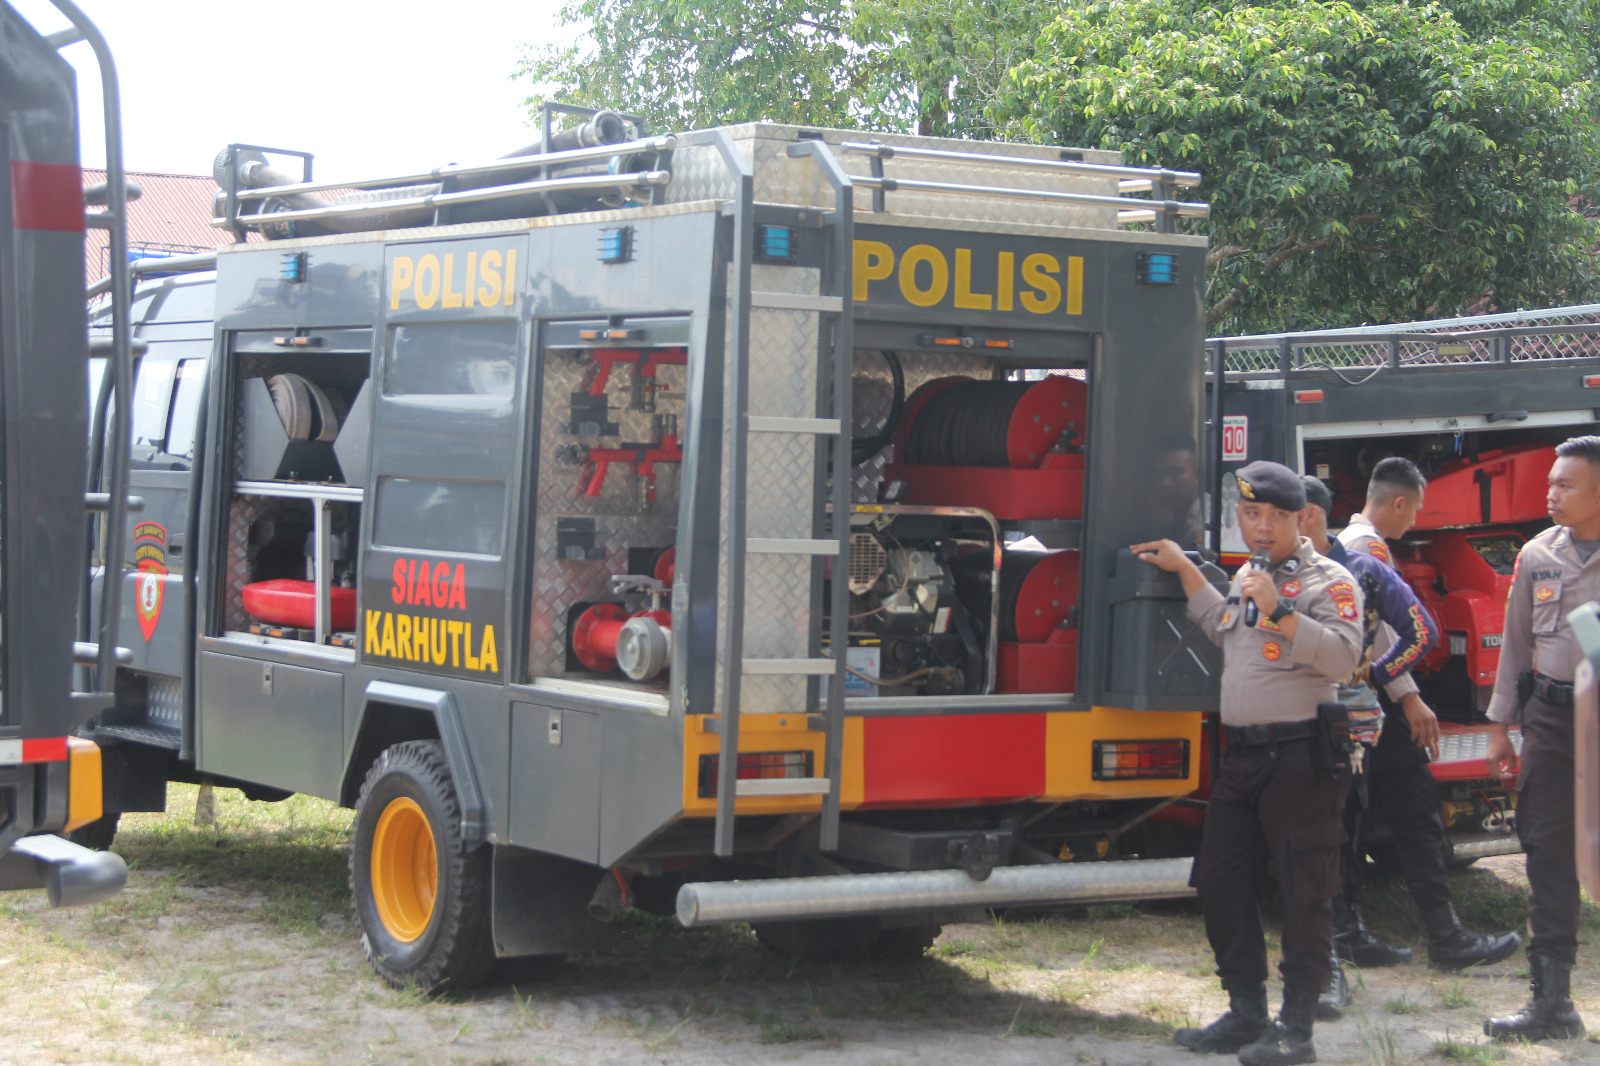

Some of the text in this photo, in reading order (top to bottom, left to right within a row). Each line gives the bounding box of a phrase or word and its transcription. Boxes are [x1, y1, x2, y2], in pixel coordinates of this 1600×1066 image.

[390, 249, 517, 310] POLISI
[852, 239, 1084, 316] POLISI
[1225, 428, 1244, 451] 10
[391, 558, 467, 610] SIAGA
[1531, 570, 1562, 581] RYAN
[365, 609, 498, 673] KARHUTLA
